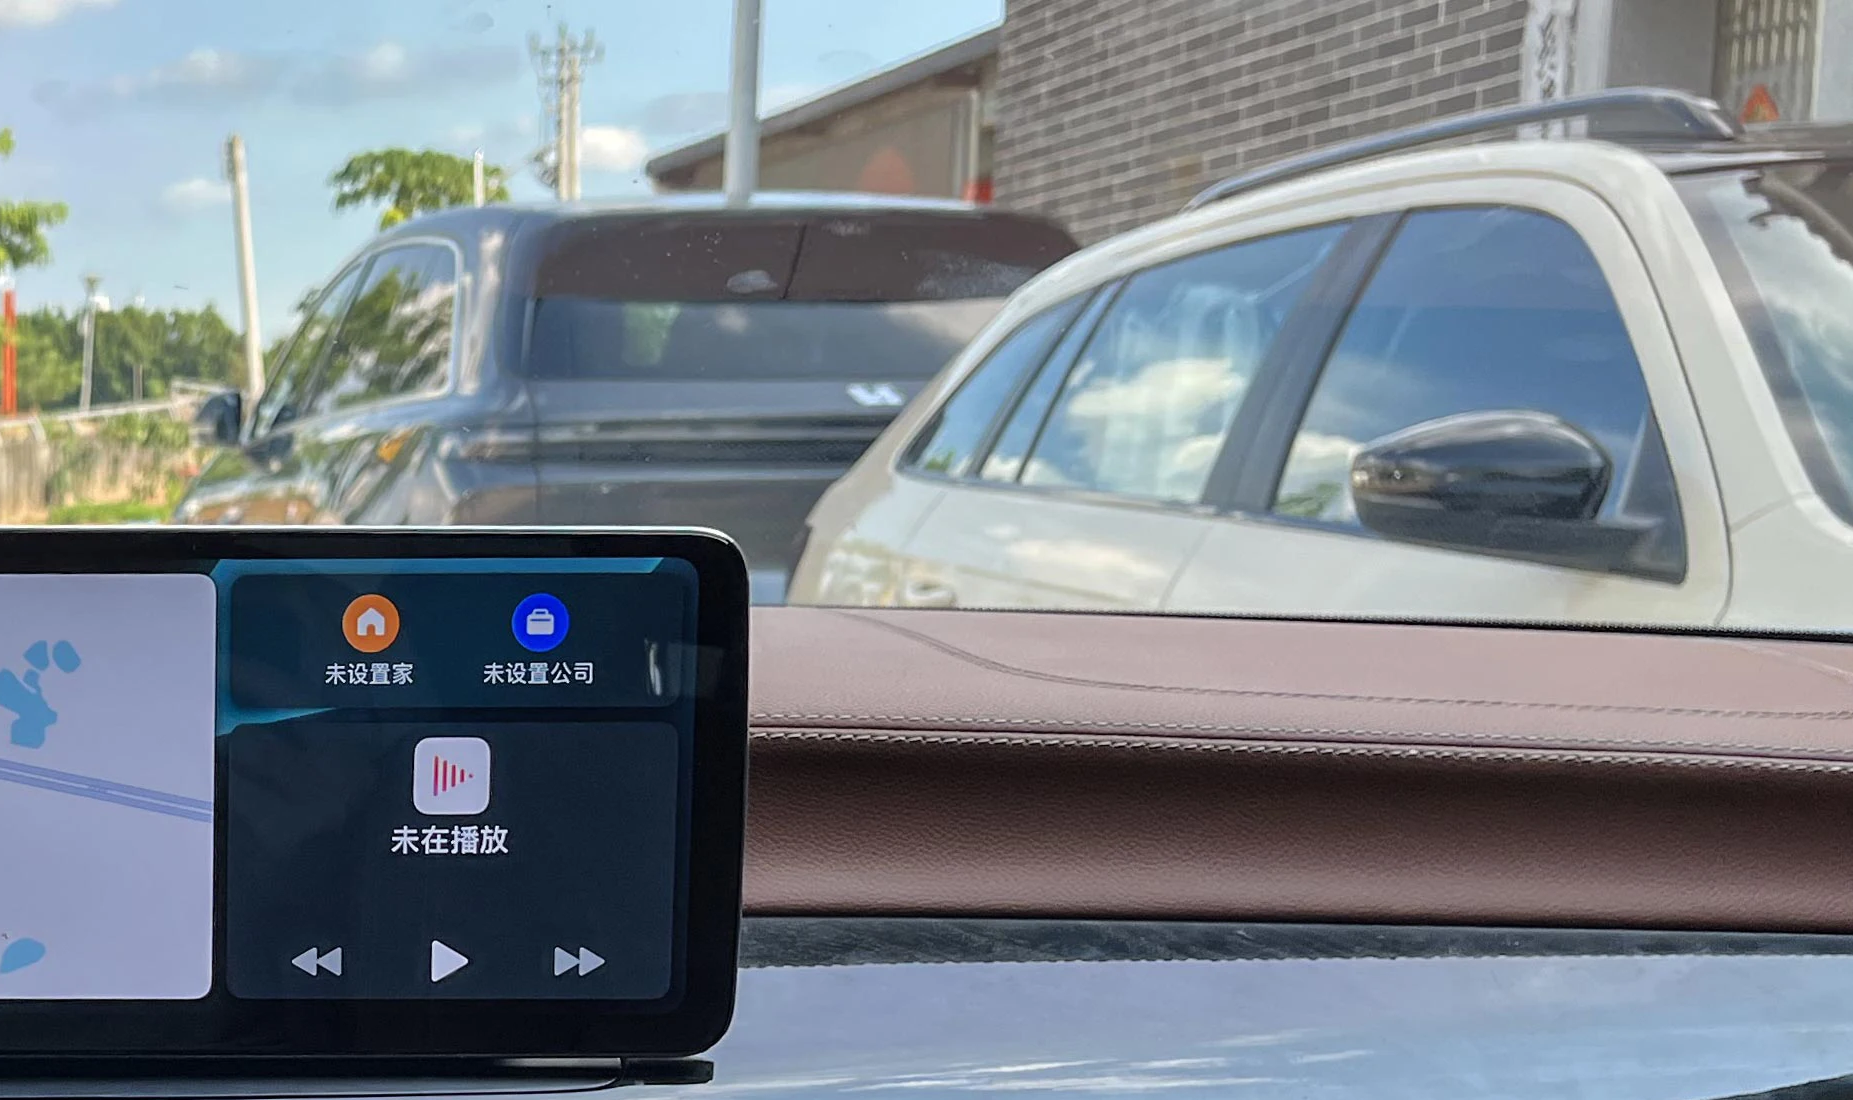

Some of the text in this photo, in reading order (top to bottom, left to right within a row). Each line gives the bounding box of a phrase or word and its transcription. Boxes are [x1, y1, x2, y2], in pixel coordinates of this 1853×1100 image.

[325, 662, 414, 685] 未设置家
[483, 661, 594, 685] 未设置公司
[391, 825, 509, 855] 未在播放
